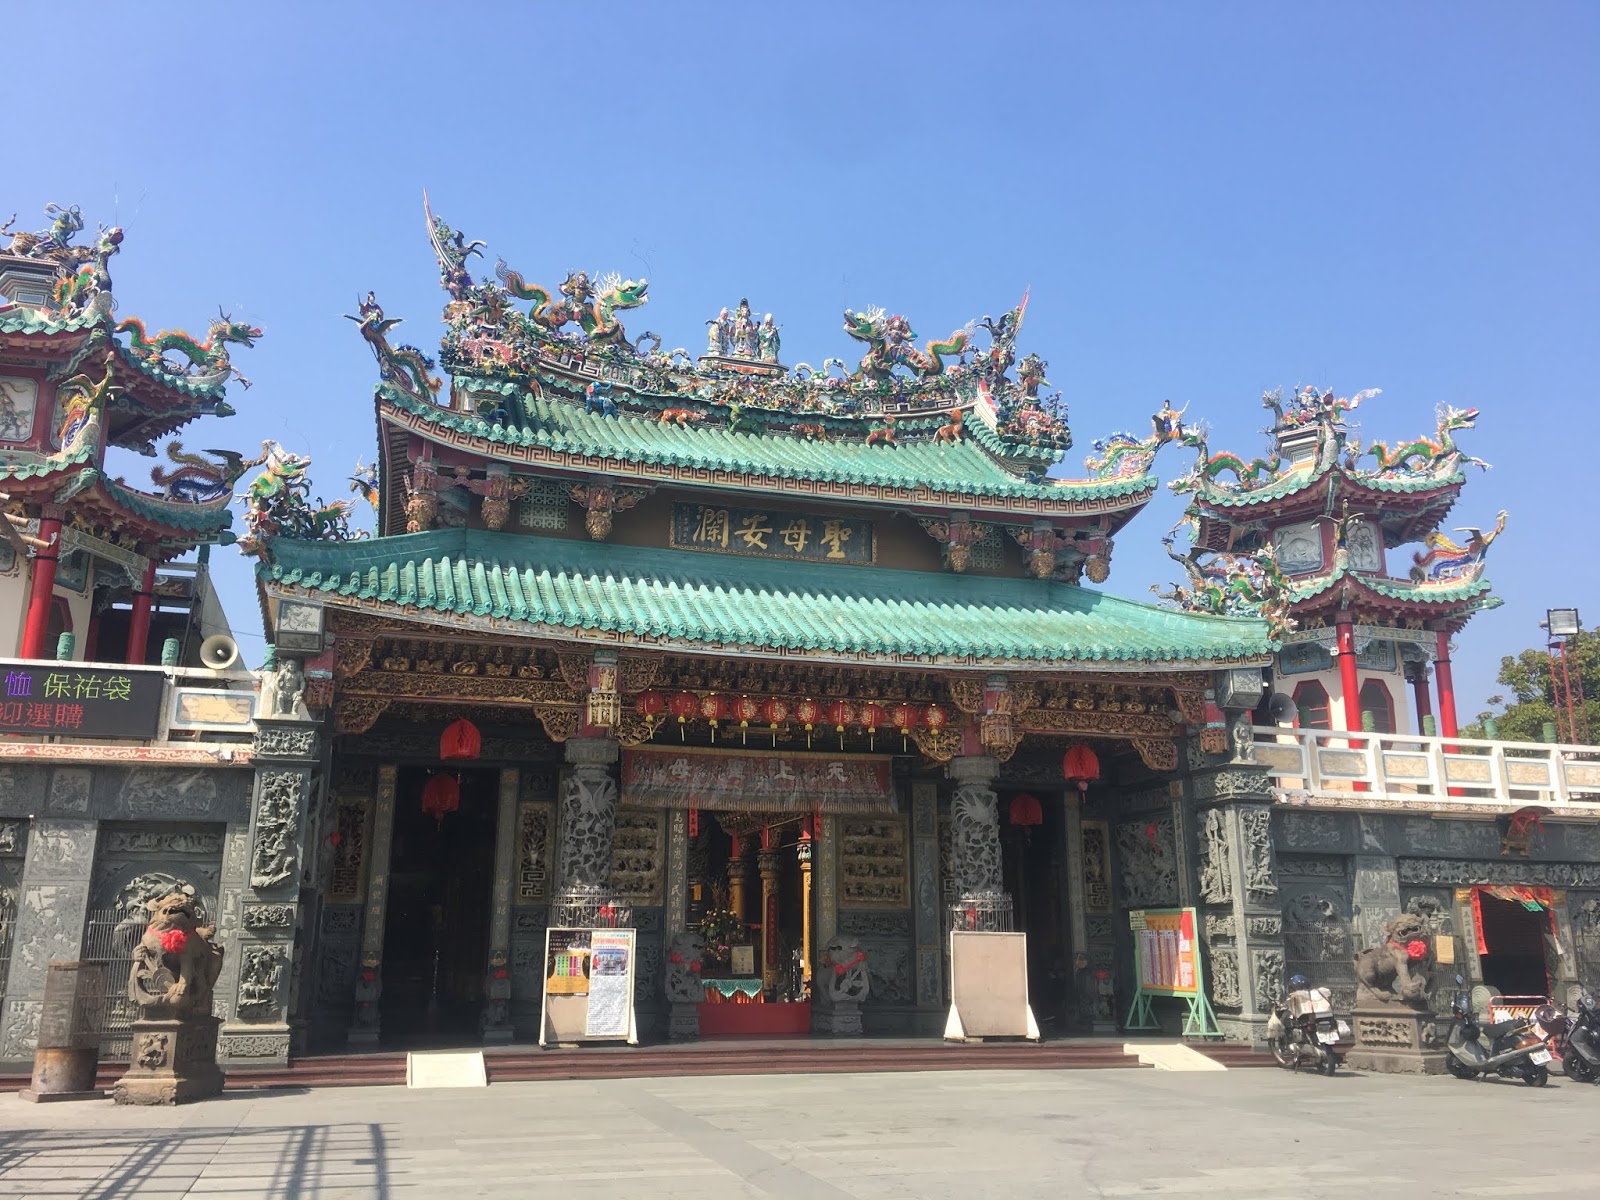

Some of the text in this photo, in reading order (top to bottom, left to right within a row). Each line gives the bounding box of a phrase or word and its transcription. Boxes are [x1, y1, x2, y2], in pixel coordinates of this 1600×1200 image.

[693, 506, 853, 559] 聖母安瀾
[5, 671, 132, 701] 恤 保祐袋
[0, 701, 84, 729] 迎選購
[669, 757, 848, 783] 天上聖母
